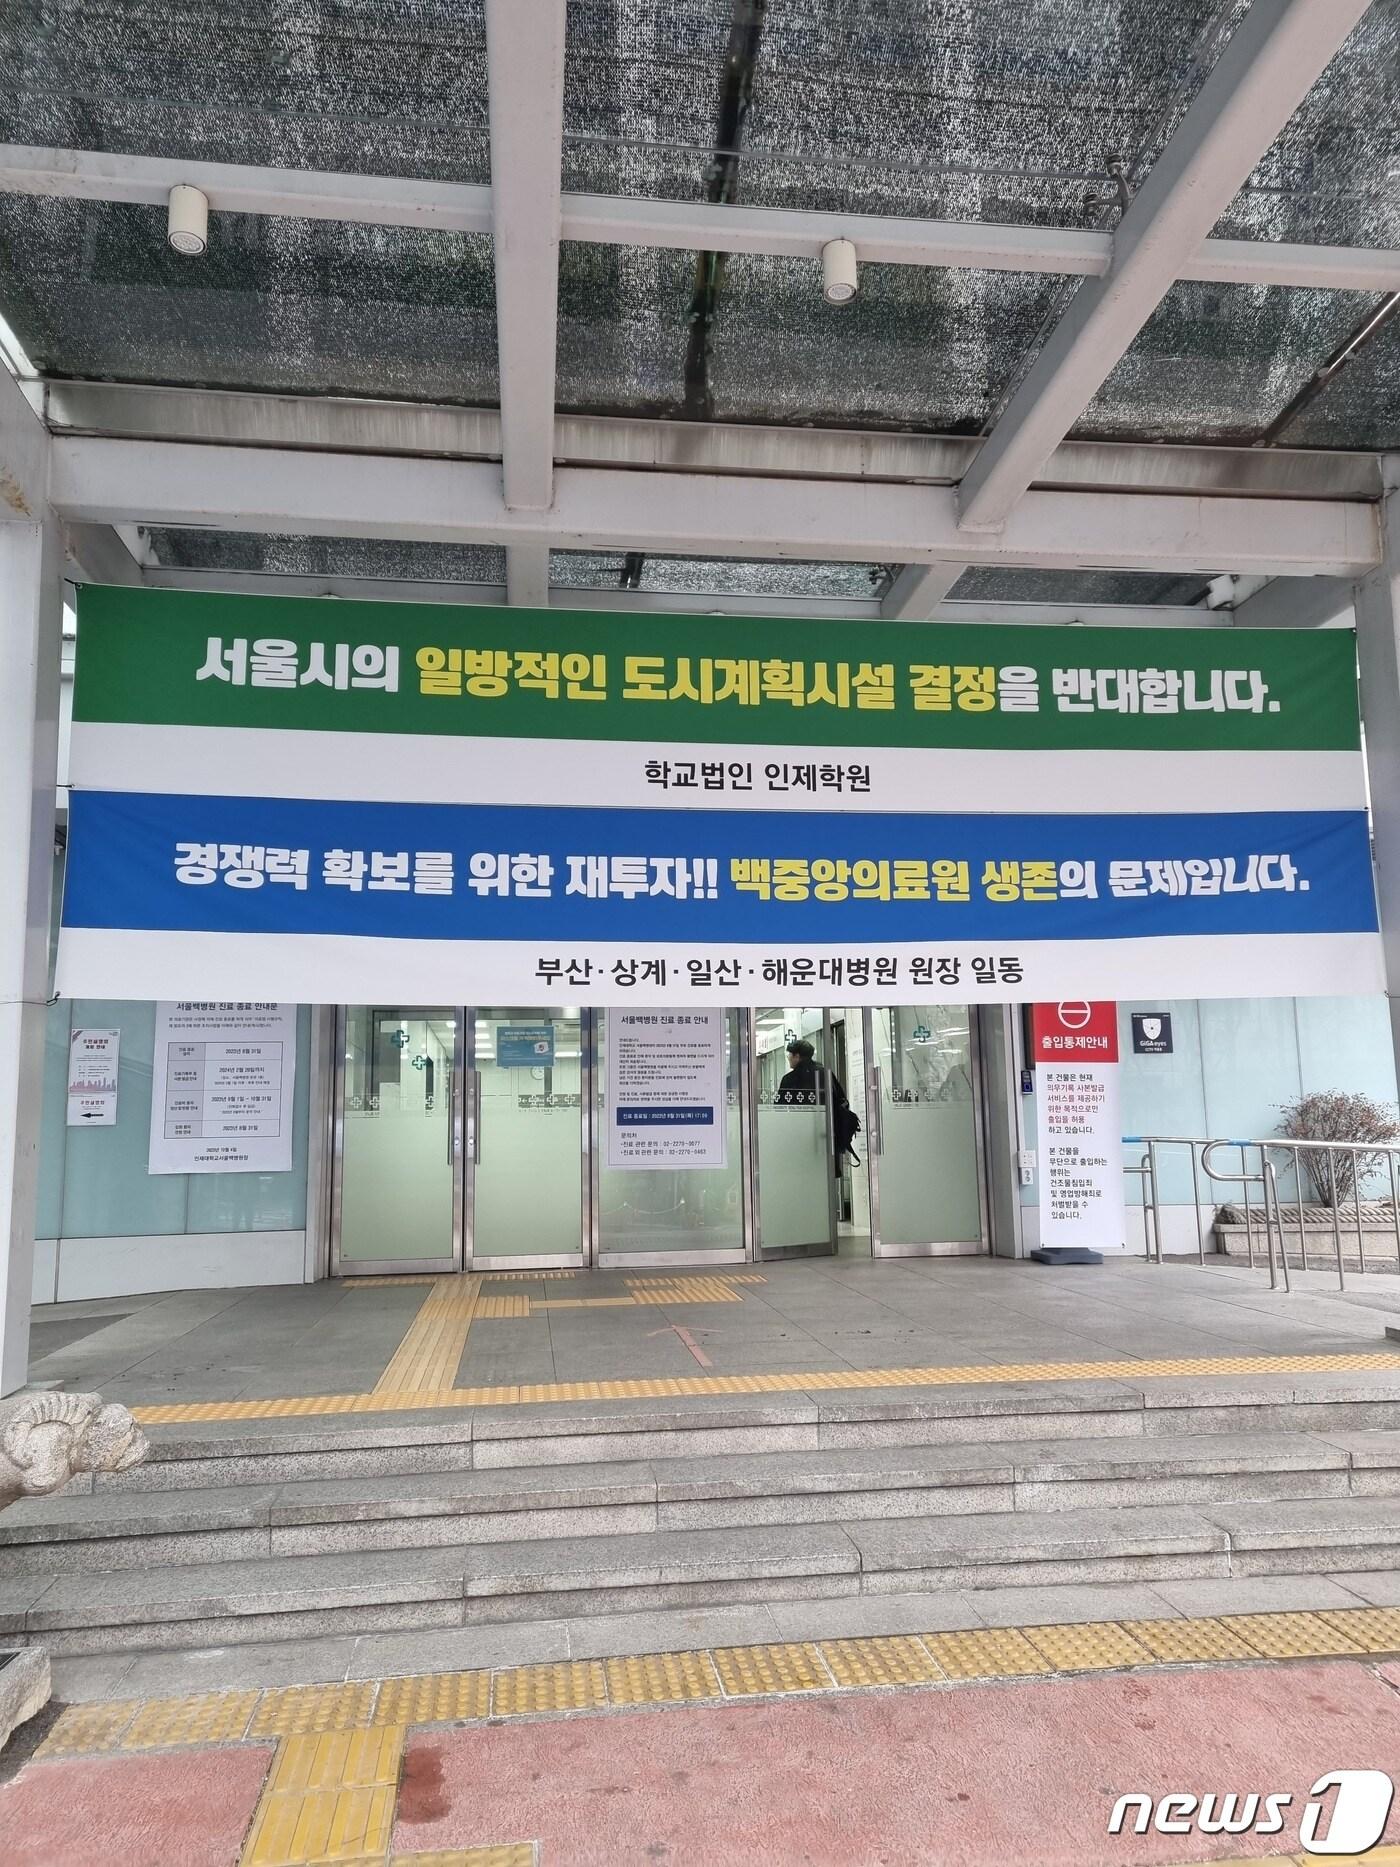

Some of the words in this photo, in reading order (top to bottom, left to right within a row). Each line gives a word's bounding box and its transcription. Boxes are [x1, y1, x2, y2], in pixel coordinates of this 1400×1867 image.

[196, 637, 399, 693] 서울시의
[415, 647, 607, 700] 일방적인
[622, 656, 895, 710] 도시계획시설
[909, 665, 1040, 712] 결정을
[1052, 668, 1281, 714] 반대합니다.
[644, 760, 753, 791] 학교법인
[764, 763, 871, 793] 인제학원
[174, 842, 310, 891] 경쟁력
[322, 848, 455, 895] 확보를
[468, 852, 555, 898] 위한
[565, 855, 718, 900] 재투자!!
[730, 858, 971, 902] 백중앙의료원
[981, 860, 1099, 902] 생존의
[1108, 854, 1310, 898] 문제입니다.
[909, 957, 961, 985] 원장
[971, 957, 1024, 984] 일동
[176, 1002, 217, 1011] 서울백병원
[218, 1002, 234, 1011] 진료
[254, 1003, 278, 1011] 안내문
[621, 1016, 658, 1025] 서울백병원
[660, 1016, 676, 1025] 진료
[677, 1016, 692, 1025] 종료
[693, 1016, 709, 1025] 안내
[1041, 1035, 1108, 1049] 출입통제안내
[1046, 1073, 1053, 1081] 본
[1056, 1073, 1077, 1081] 건물은
[1079, 1073, 1093, 1081] 현재
[1047, 1083, 1075, 1092] 의무기록
[1077, 1083, 1105, 1092] 사본발급
[1047, 1094, 1075, 1102] 서비스를
[1077, 1094, 1105, 1102] 제공하기
[1047, 1105, 1061, 1113] 위한
[1063, 1104, 1099, 1113] 목적으로만
[1048, 1115, 1069, 1124] 출입을
[1071, 1115, 1085, 1123] 허용
[1048, 1126, 1062, 1134] 하고
[1064, 1126, 1095, 1134] 있습니다.
[1049, 1147, 1056, 1155] 본
[1058, 1146, 1079, 1155] 건물을
[1049, 1158, 1078, 1166] 무단으로
[1079, 1158, 1108, 1166] 출입하는
[1050, 1168, 1071, 1176] 행위는
[1051, 1200, 1079, 1209] 처벌받을
[1051, 1211, 1082, 1220] 있습니다.
